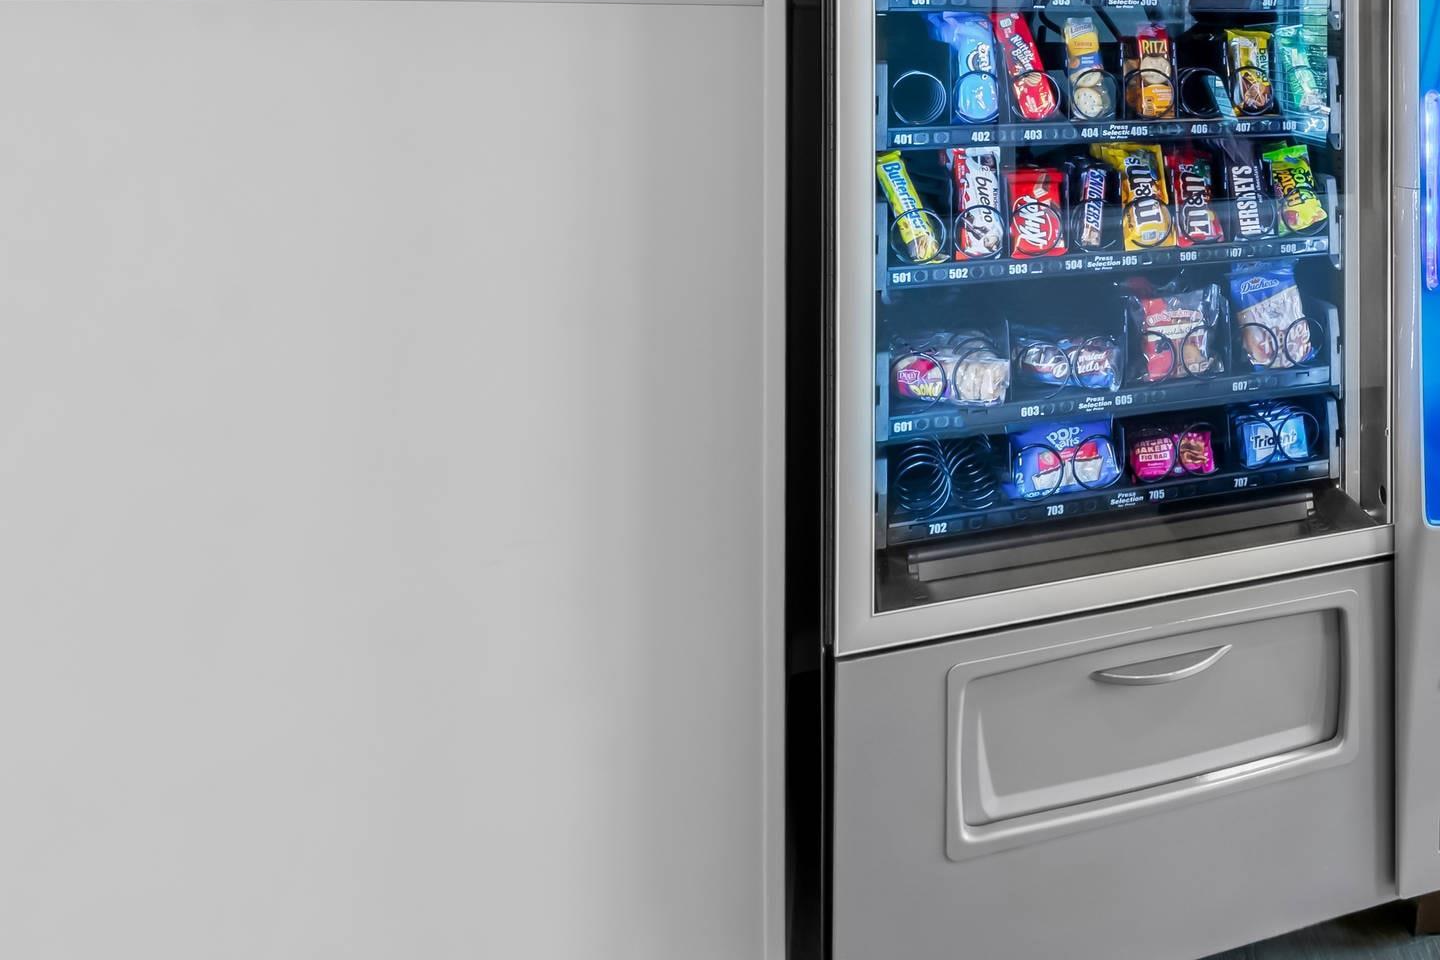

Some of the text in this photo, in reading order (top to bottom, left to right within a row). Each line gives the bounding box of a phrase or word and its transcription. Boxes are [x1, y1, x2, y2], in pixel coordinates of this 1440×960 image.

[1142, 39, 1166, 55] RITZ
[1081, 127, 1099, 138] 404
[1131, 126, 1148, 136] 405
[1190, 124, 1208, 134] 406
[1235, 123, 1251, 132] 407
[894, 133, 912, 145] 401
[971, 131, 990, 142] 402
[1024, 130, 1043, 140] 403
[974, 176, 993, 223] bueno
[1086, 169, 1105, 230] SNICKERS
[1231, 165, 1261, 235] HERSHEY'S
[1280, 244, 1297, 254] 508
[1180, 251, 1197, 261] 506
[1008, 263, 1028, 275] 503
[1065, 259, 1083, 270] 504
[1087, 260, 1121, 268] Selection
[892, 272, 911, 283] 501
[949, 268, 968, 279] 502
[1232, 381, 1248, 391] 607
[1078, 400, 1112, 410] Selection
[1115, 394, 1133, 406] 605
[1021, 405, 1040, 418] 603
[893, 420, 913, 433] 601
[1233, 477, 1248, 488] 707
[1148, 489, 1165, 500] 705
[1110, 496, 1144, 506] Selection
[1046, 504, 1064, 516] 703
[928, 522, 948, 535] 702
